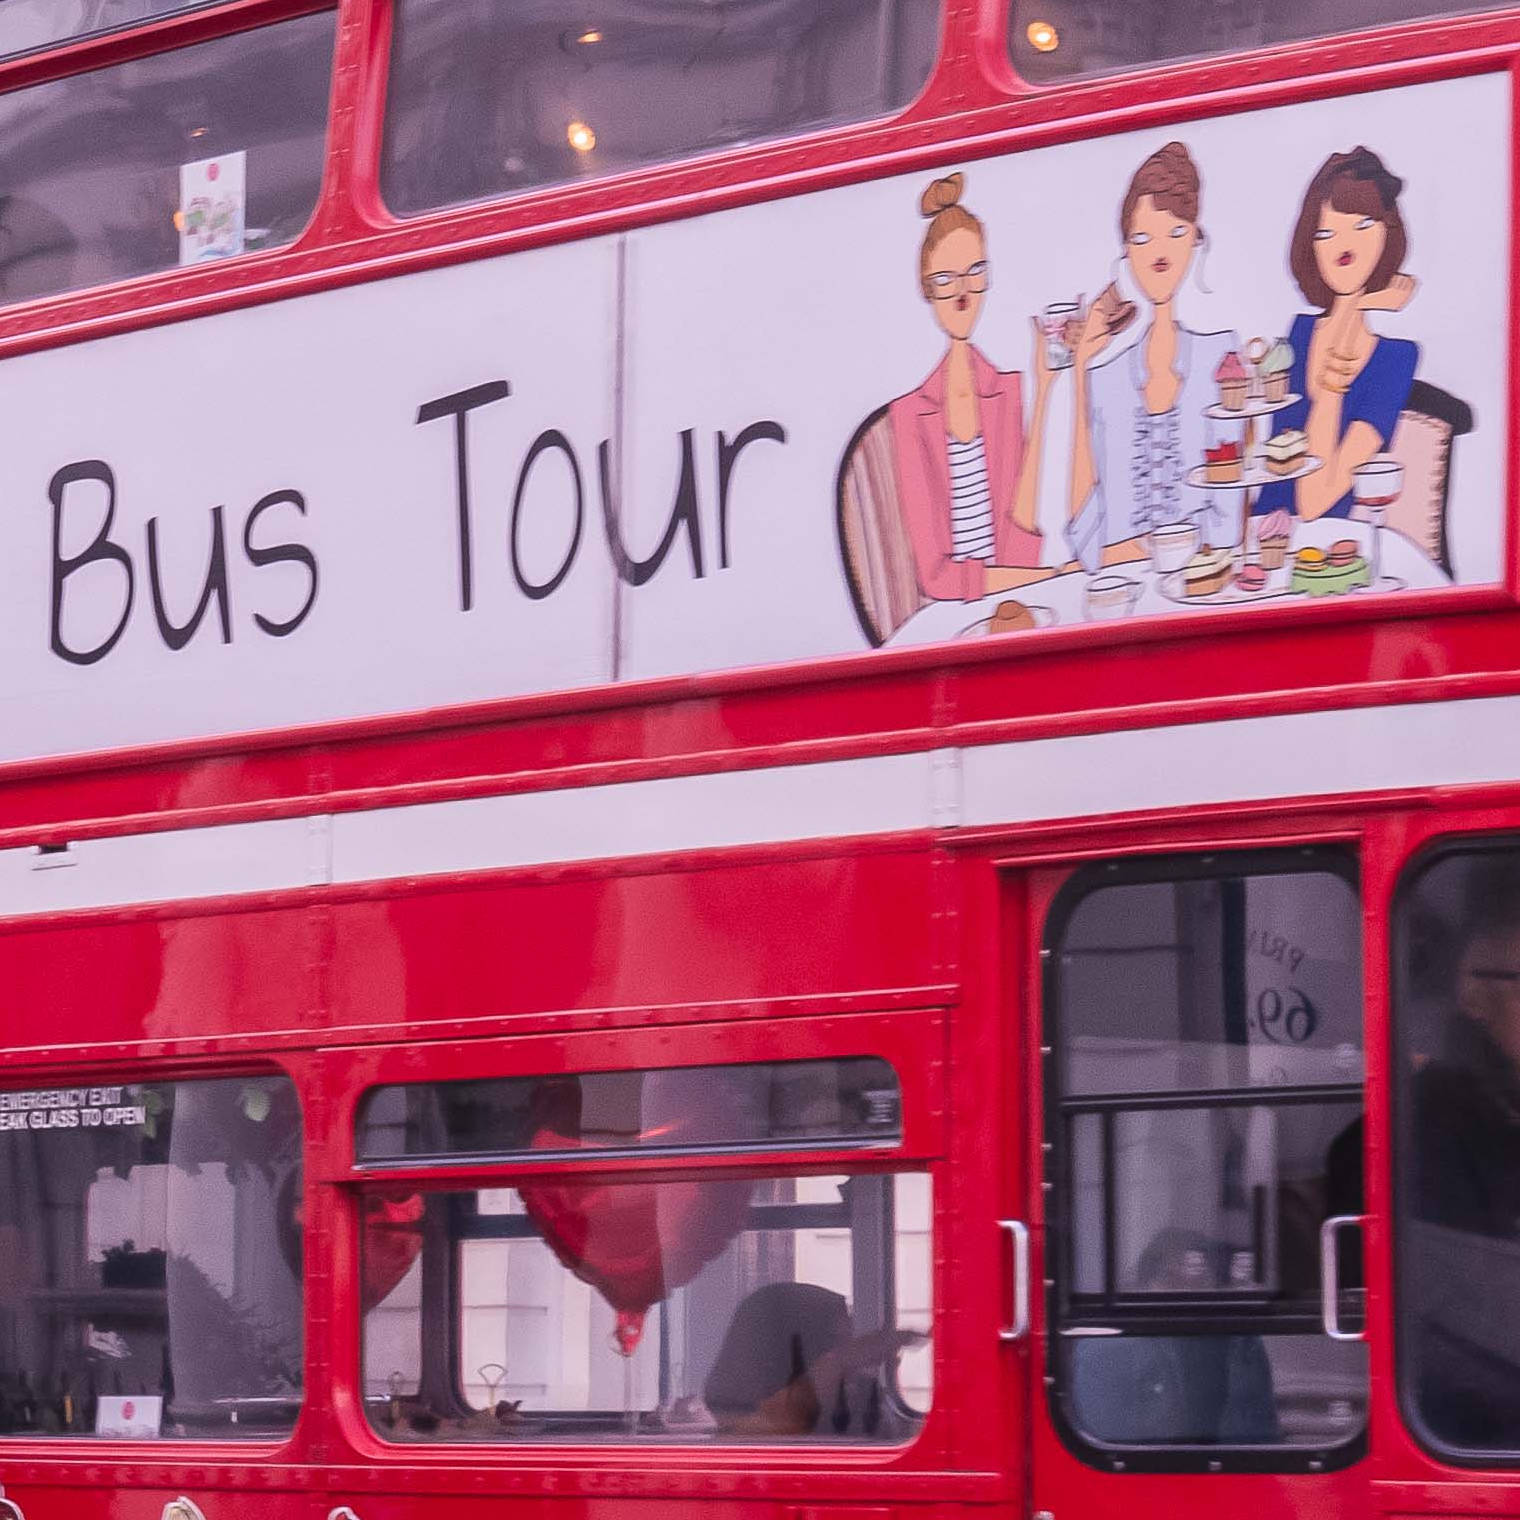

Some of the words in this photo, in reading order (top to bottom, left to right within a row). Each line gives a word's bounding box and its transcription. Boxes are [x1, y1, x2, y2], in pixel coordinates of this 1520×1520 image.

[49, 459, 319, 666] Bus
[415, 379, 788, 612] Tour
[30, 1108, 80, 1130] GLASS
[80, 1107, 102, 1127] TO
[102, 1105, 147, 1126] OPEN
